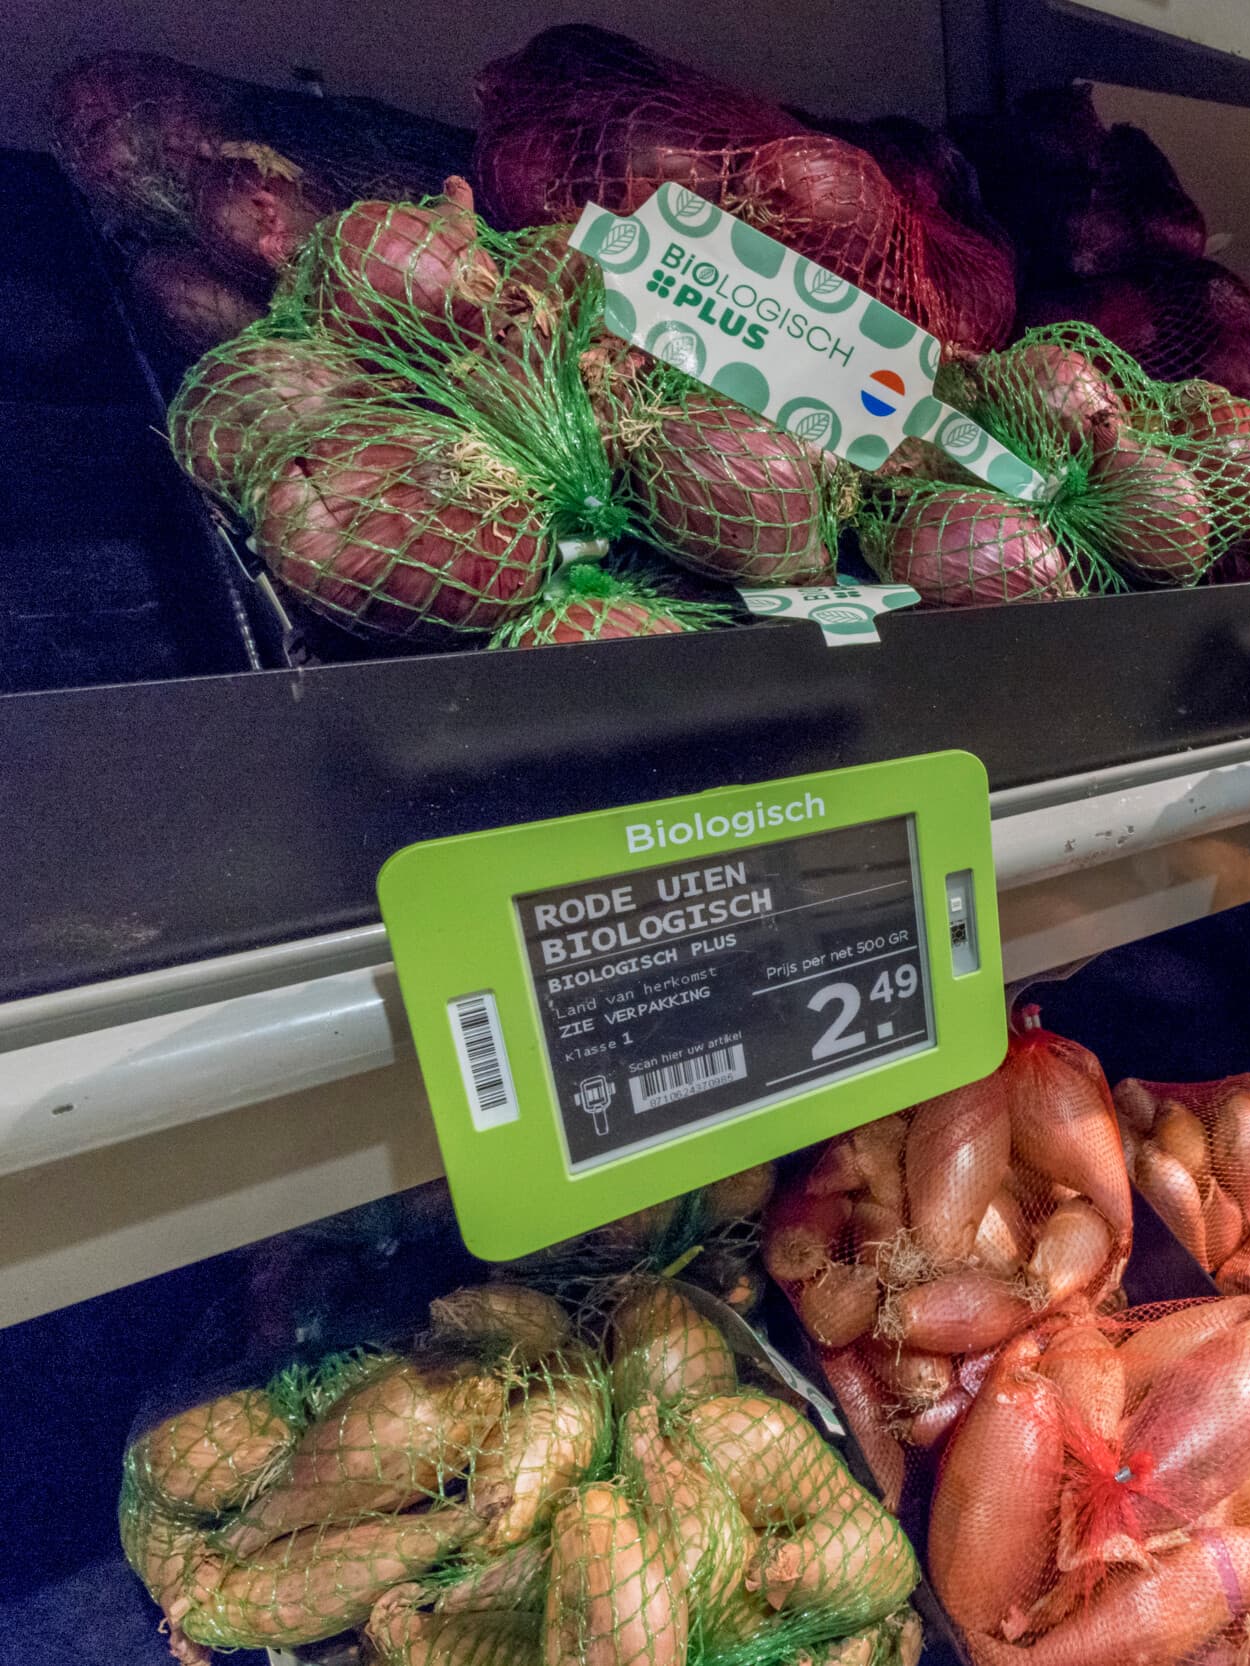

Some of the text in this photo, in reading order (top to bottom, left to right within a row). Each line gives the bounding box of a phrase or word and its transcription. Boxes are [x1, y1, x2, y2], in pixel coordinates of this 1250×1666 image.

[672, 283, 770, 350] PLUS
[625, 792, 826, 854] Biologisch
[534, 861, 747, 932] RODE UIEN
[541, 888, 773, 965] BIOLOGISCH
[766, 929, 910, 980] Prijs per net 500 GR
[547, 933, 737, 994] BIOLOGISCH PLUS
[556, 967, 718, 1020] Land van herkomst
[559, 986, 711, 1039] ZIE VERPAKKING
[622, 1031, 635, 1046] 1
[629, 1030, 743, 1073] Scan hier uw artikel
